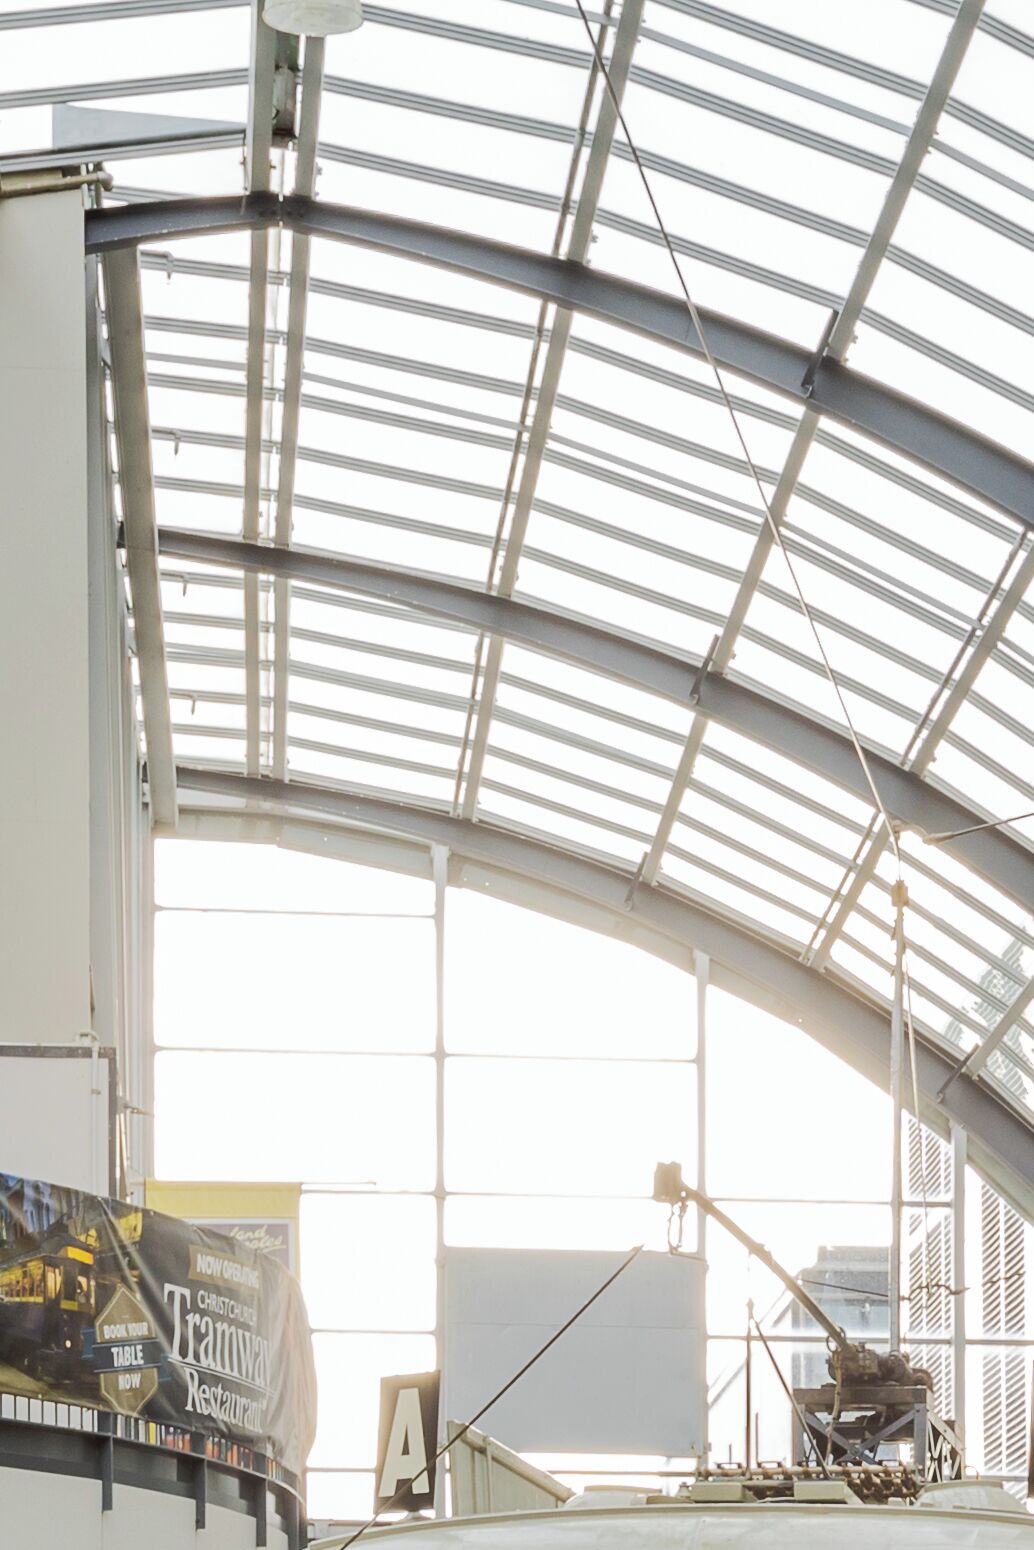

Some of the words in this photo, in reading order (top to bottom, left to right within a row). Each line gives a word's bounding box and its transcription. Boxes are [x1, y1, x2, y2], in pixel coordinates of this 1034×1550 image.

[196, 1253, 221, 1278] NOW
[222, 1260, 259, 1288] OPERATING
[197, 1290, 257, 1325] CHRISTCHURCH
[103, 1324, 127, 1340] BOOK
[128, 1321, 149, 1337] YOUR
[164, 1283, 273, 1398] Tramway
[111, 1345, 144, 1366] TABLE
[118, 1374, 141, 1390] NOW
[184, 1368, 266, 1433] Restaurant
[378, 1387, 429, 1498] A
